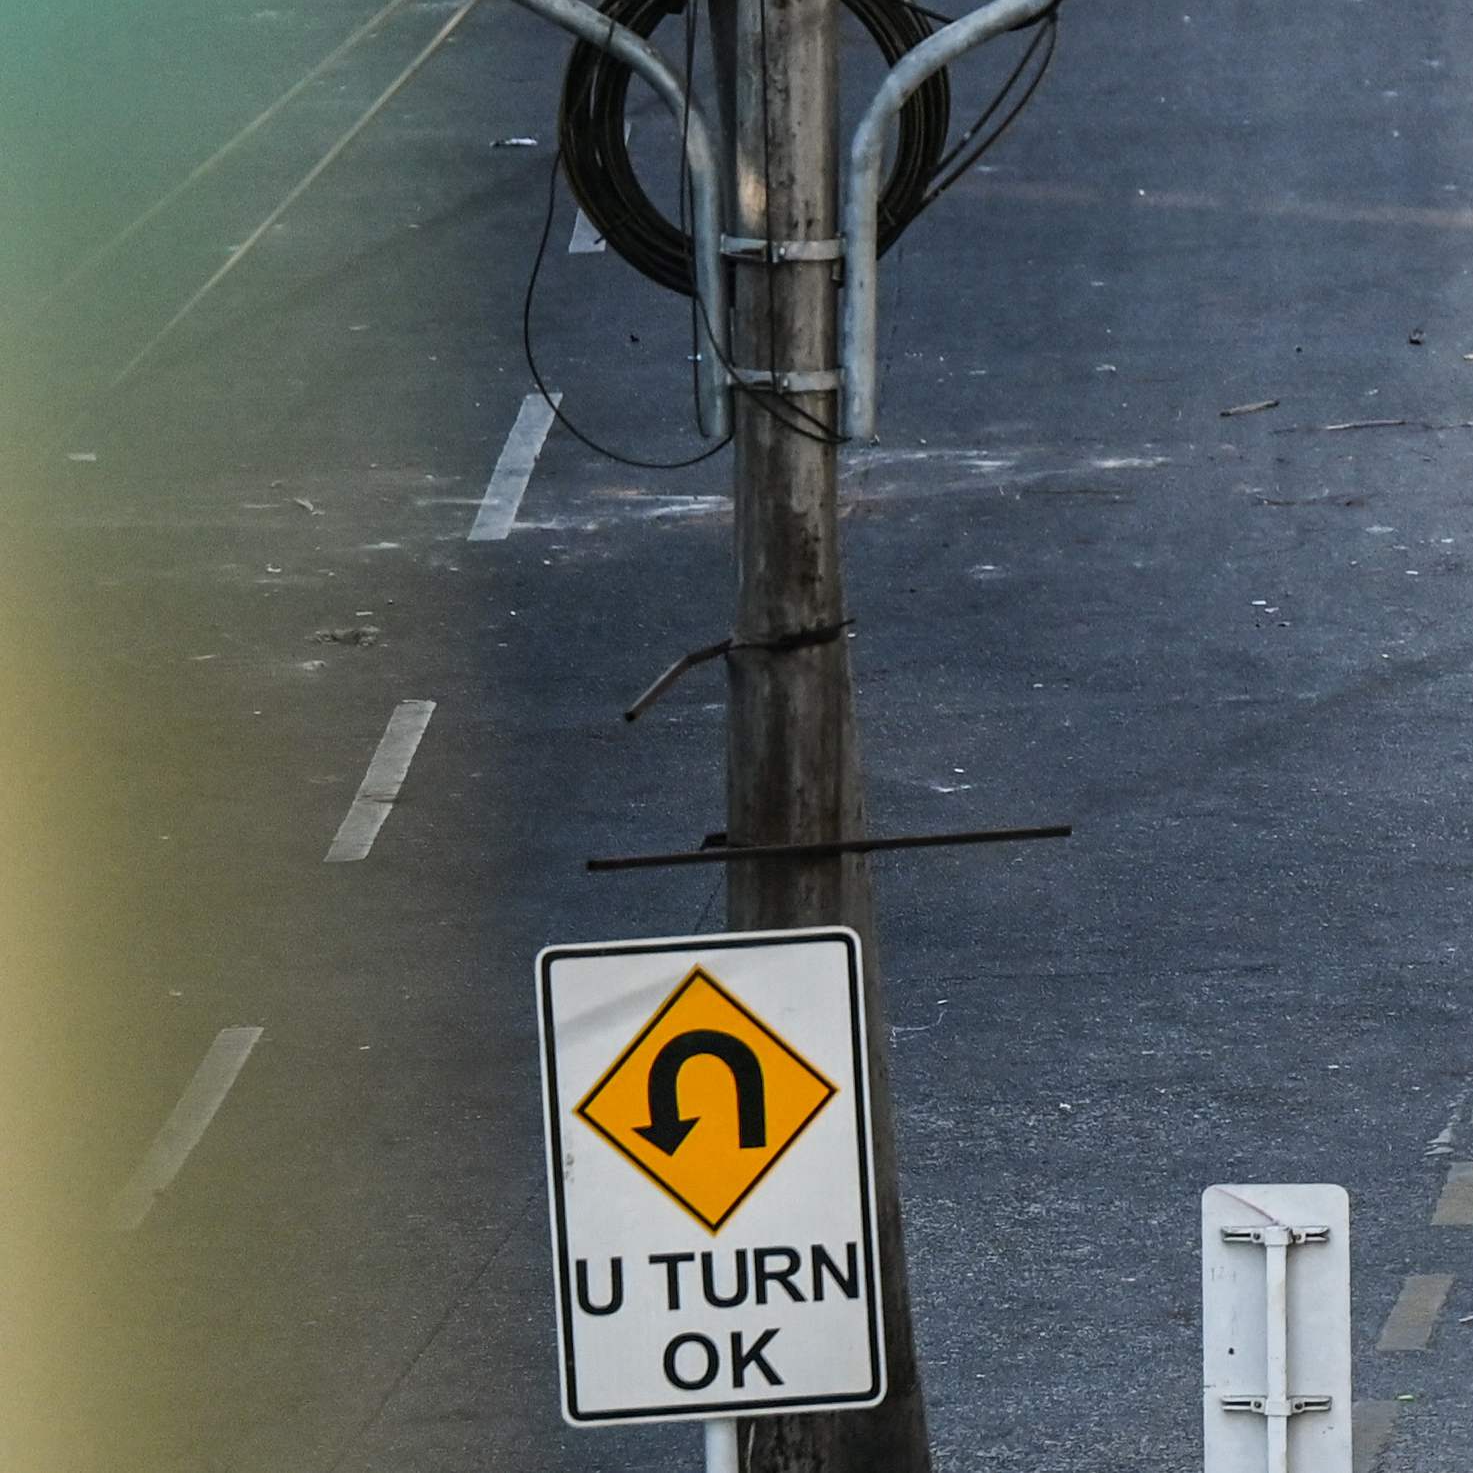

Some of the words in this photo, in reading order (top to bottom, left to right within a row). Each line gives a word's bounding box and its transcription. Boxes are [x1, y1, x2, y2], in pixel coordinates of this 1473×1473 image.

[576, 1257, 623, 1316] U
[649, 1242, 859, 1310] TURN
[663, 1328, 784, 1391] OK
